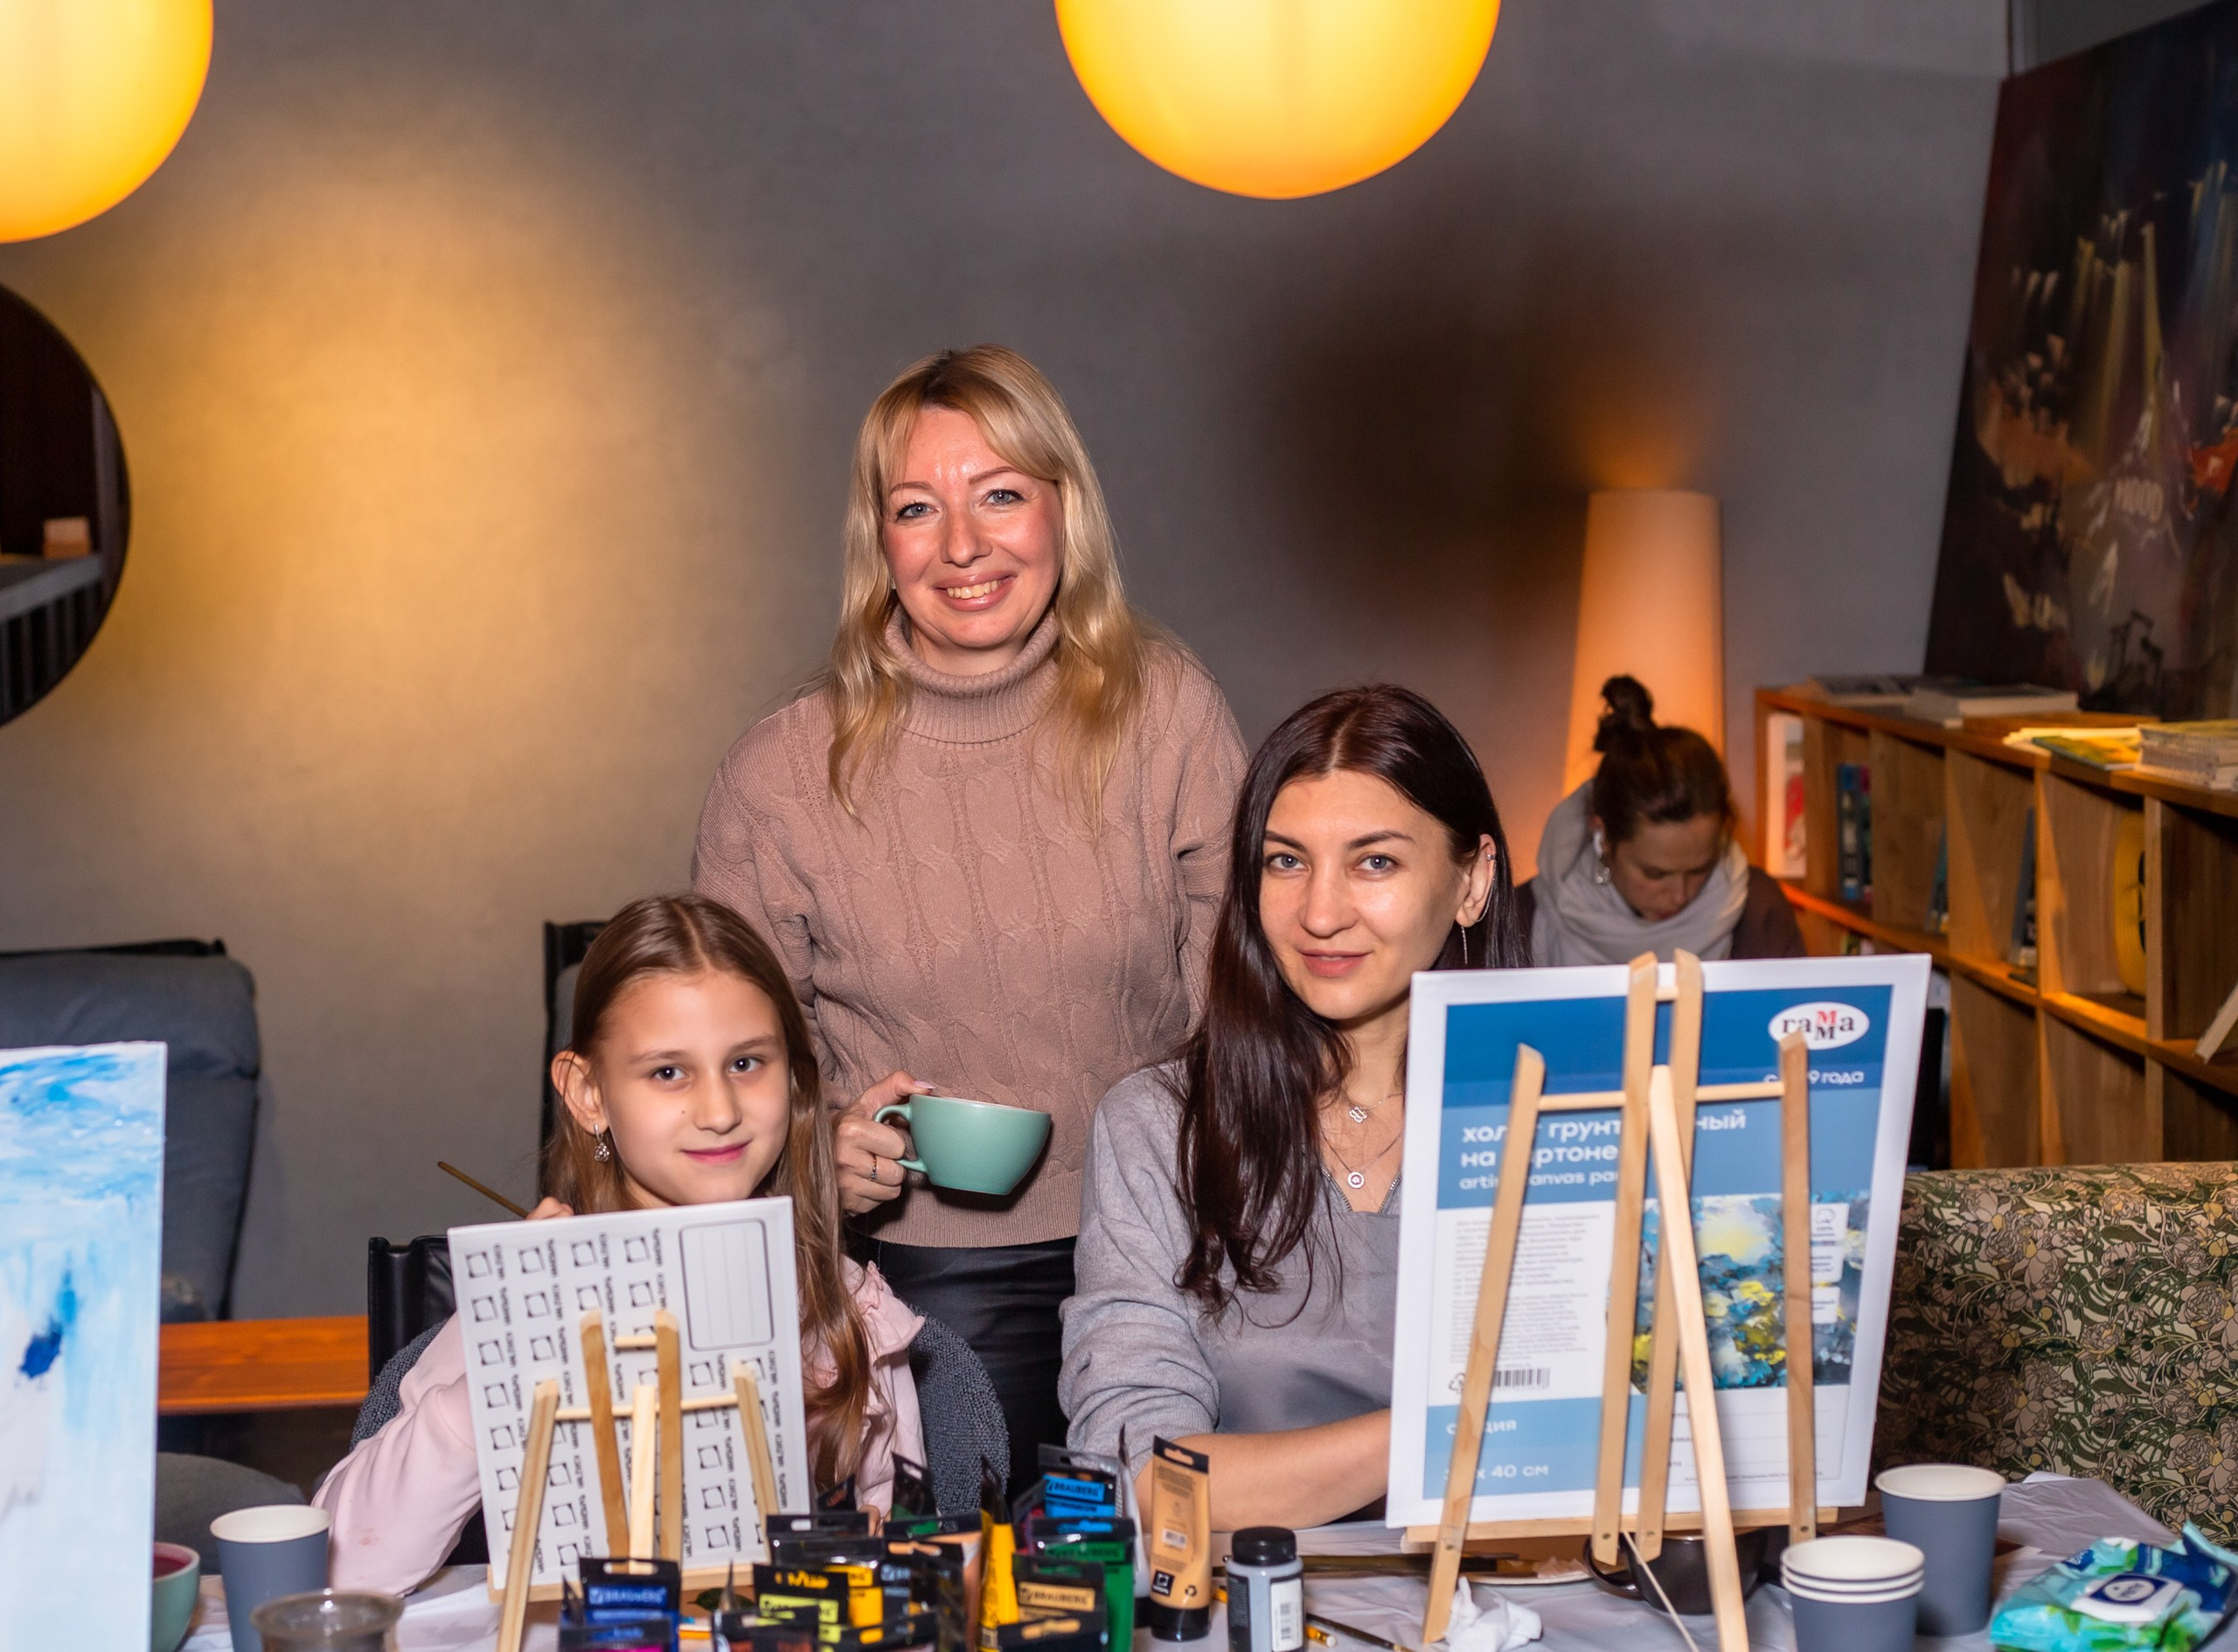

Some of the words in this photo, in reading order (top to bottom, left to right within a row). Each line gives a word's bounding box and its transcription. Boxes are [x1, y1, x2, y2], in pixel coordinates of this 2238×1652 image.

[1822, 1070, 1865, 1084] года
[1460, 1150, 1497, 1168] на
[1526, 1144, 1619, 1169] ртоне
[1528, 1171, 1586, 1187] anvas
[1491, 1464, 1517, 1478] 40
[1522, 1465, 1548, 1477] см
